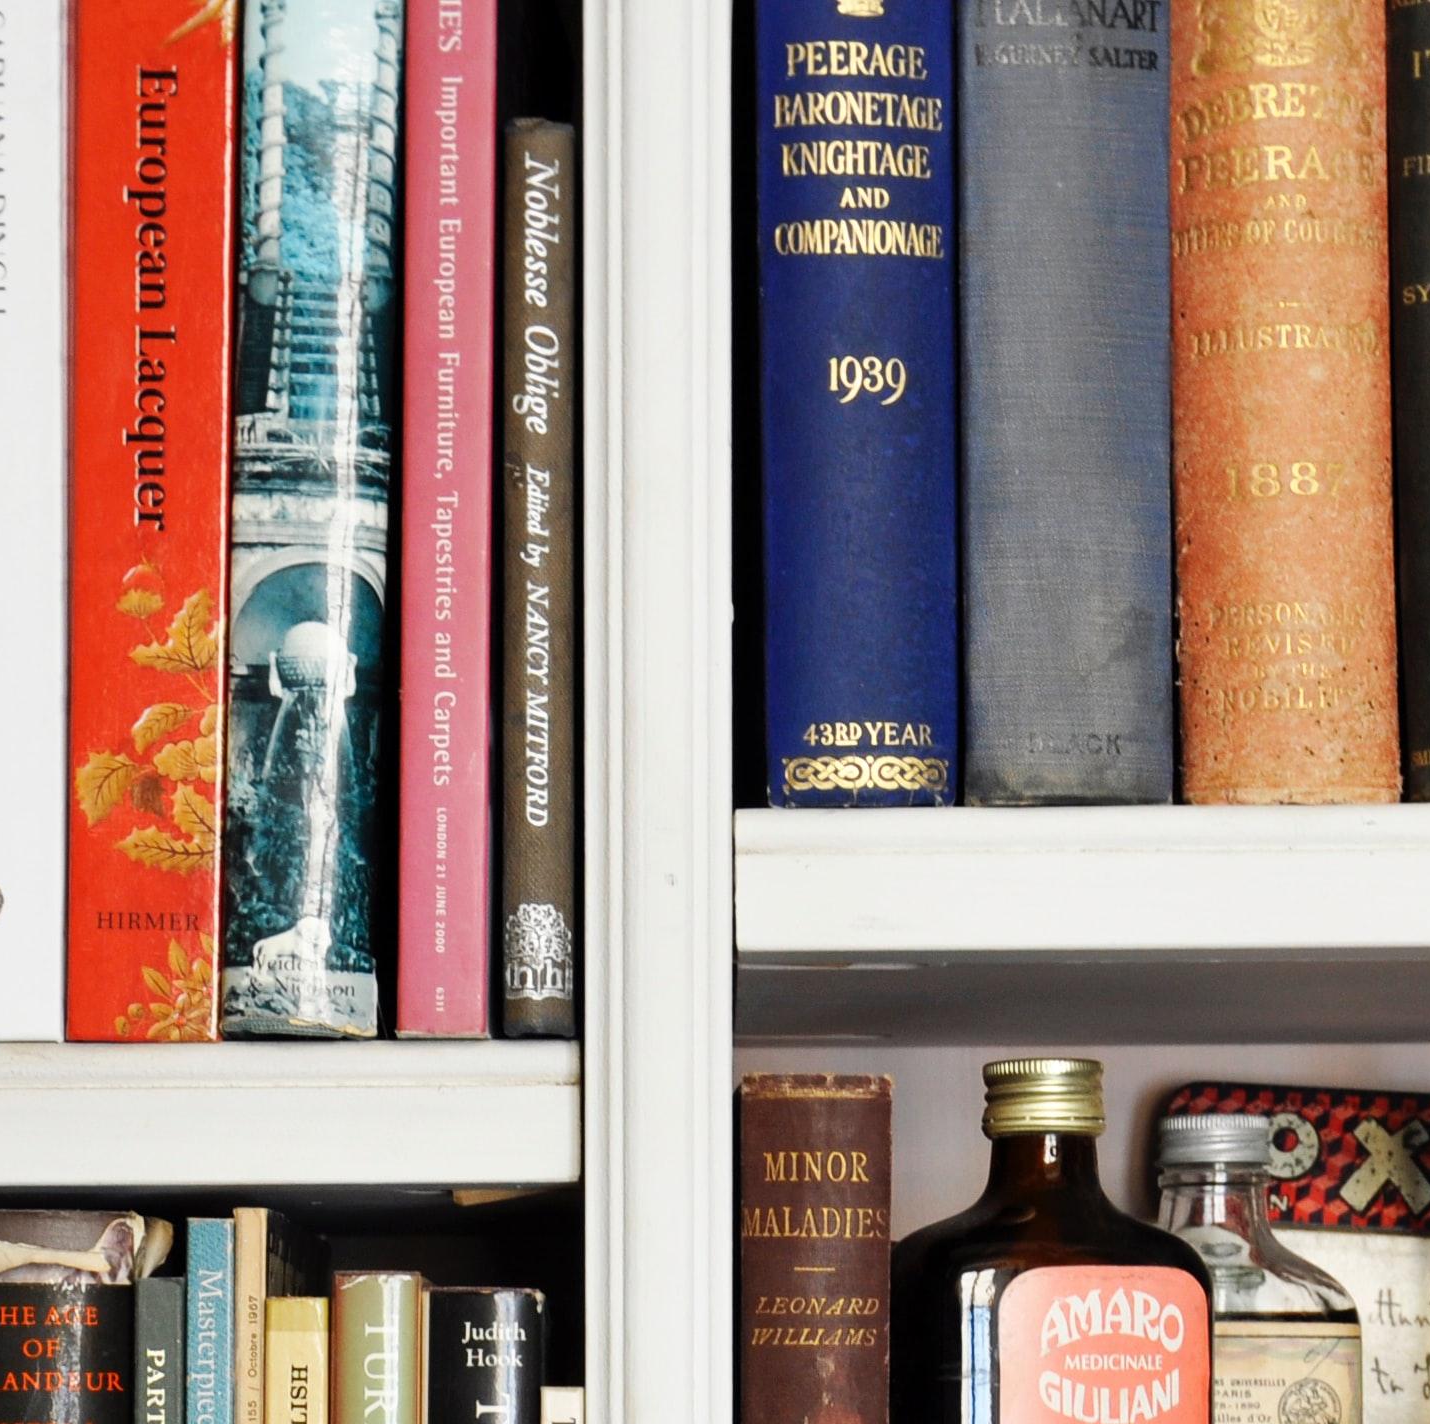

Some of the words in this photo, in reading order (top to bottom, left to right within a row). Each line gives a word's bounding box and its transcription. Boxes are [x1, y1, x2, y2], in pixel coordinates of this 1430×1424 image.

[786, 42, 928, 80] PEERAGE
[774, 92, 943, 131] BARONETAGE
[435, 75, 463, 207] Important
[781, 143, 931, 179] KNIGHTAGE
[123, 65, 180, 311] European
[839, 188, 890, 209] AND
[524, 153, 561, 308] Noblesse
[774, 220, 944, 259] COMPANIONAGE
[435, 218, 462, 340] European
[513, 324, 560, 436] Oblige
[828, 356, 907, 406] 1939
[122, 325, 179, 532] Lacquer
[433, 351, 460, 480] Furniture,
[1227, 461, 1345, 501] 1887
[431, 491, 459, 622] Tapestries
[526, 581, 551, 684] NANCY
[434, 631, 457, 681] and
[431, 690, 457, 787] Carpets
[803, 723, 862, 748] 43RD
[870, 722, 932, 747] YEAR
[525, 692, 551, 828] MITFORD
[96, 910, 200, 933] HIRMER
[762, 1151, 870, 1183] MINOR
[741, 1206, 886, 1240] MALADIES
[755, 1297, 880, 1318] LEONARD
[1039, 1285, 1186, 1358] AMARO
[22, 1339, 61, 1360] OF
[462, 1321, 526, 1344] Judith
[750, 1328, 877, 1348] WILLIAMS
[465, 1347, 524, 1369] Hook
[1063, 1353, 1164, 1373] MEDICINALE
